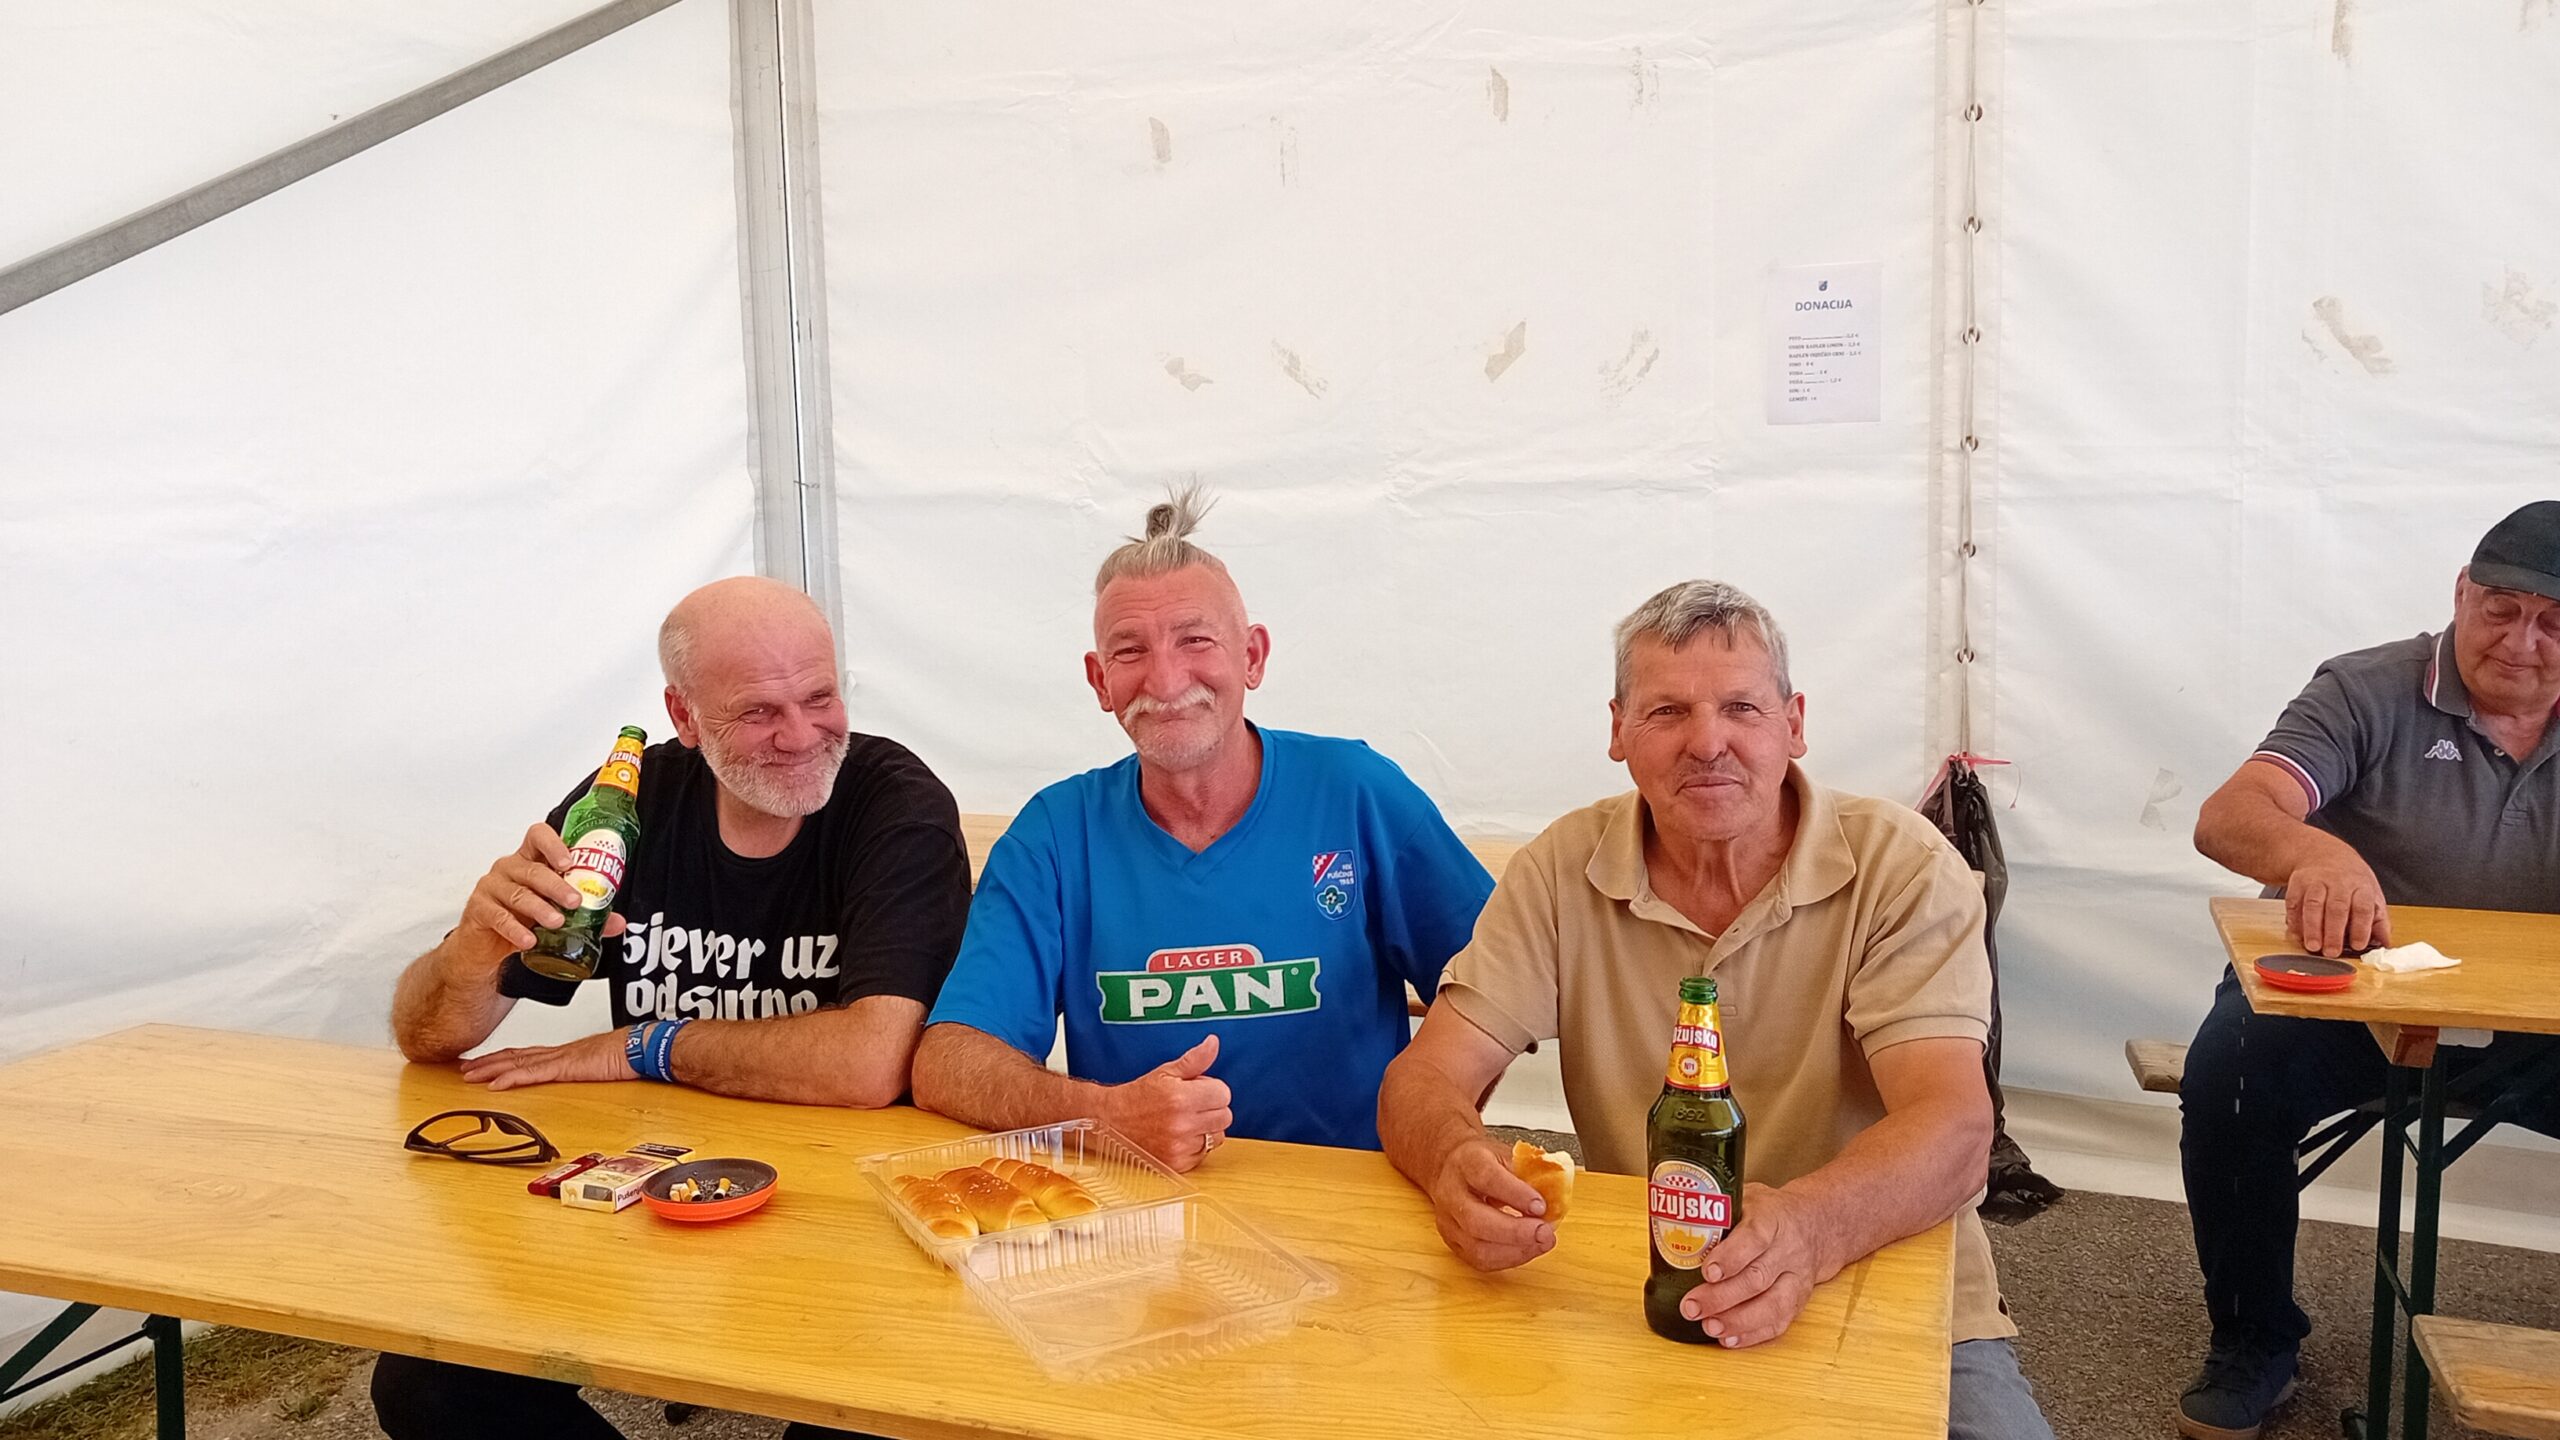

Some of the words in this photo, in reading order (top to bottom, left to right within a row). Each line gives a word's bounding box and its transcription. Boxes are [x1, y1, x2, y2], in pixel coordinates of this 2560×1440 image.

[1795, 299, 1853, 312] DONACIJA
[780, 934, 840, 980] uz
[1163, 950, 1243, 970] LAGER
[1127, 968, 1286, 1019] PAN
[1650, 1187, 1725, 1222] Ožujsko
